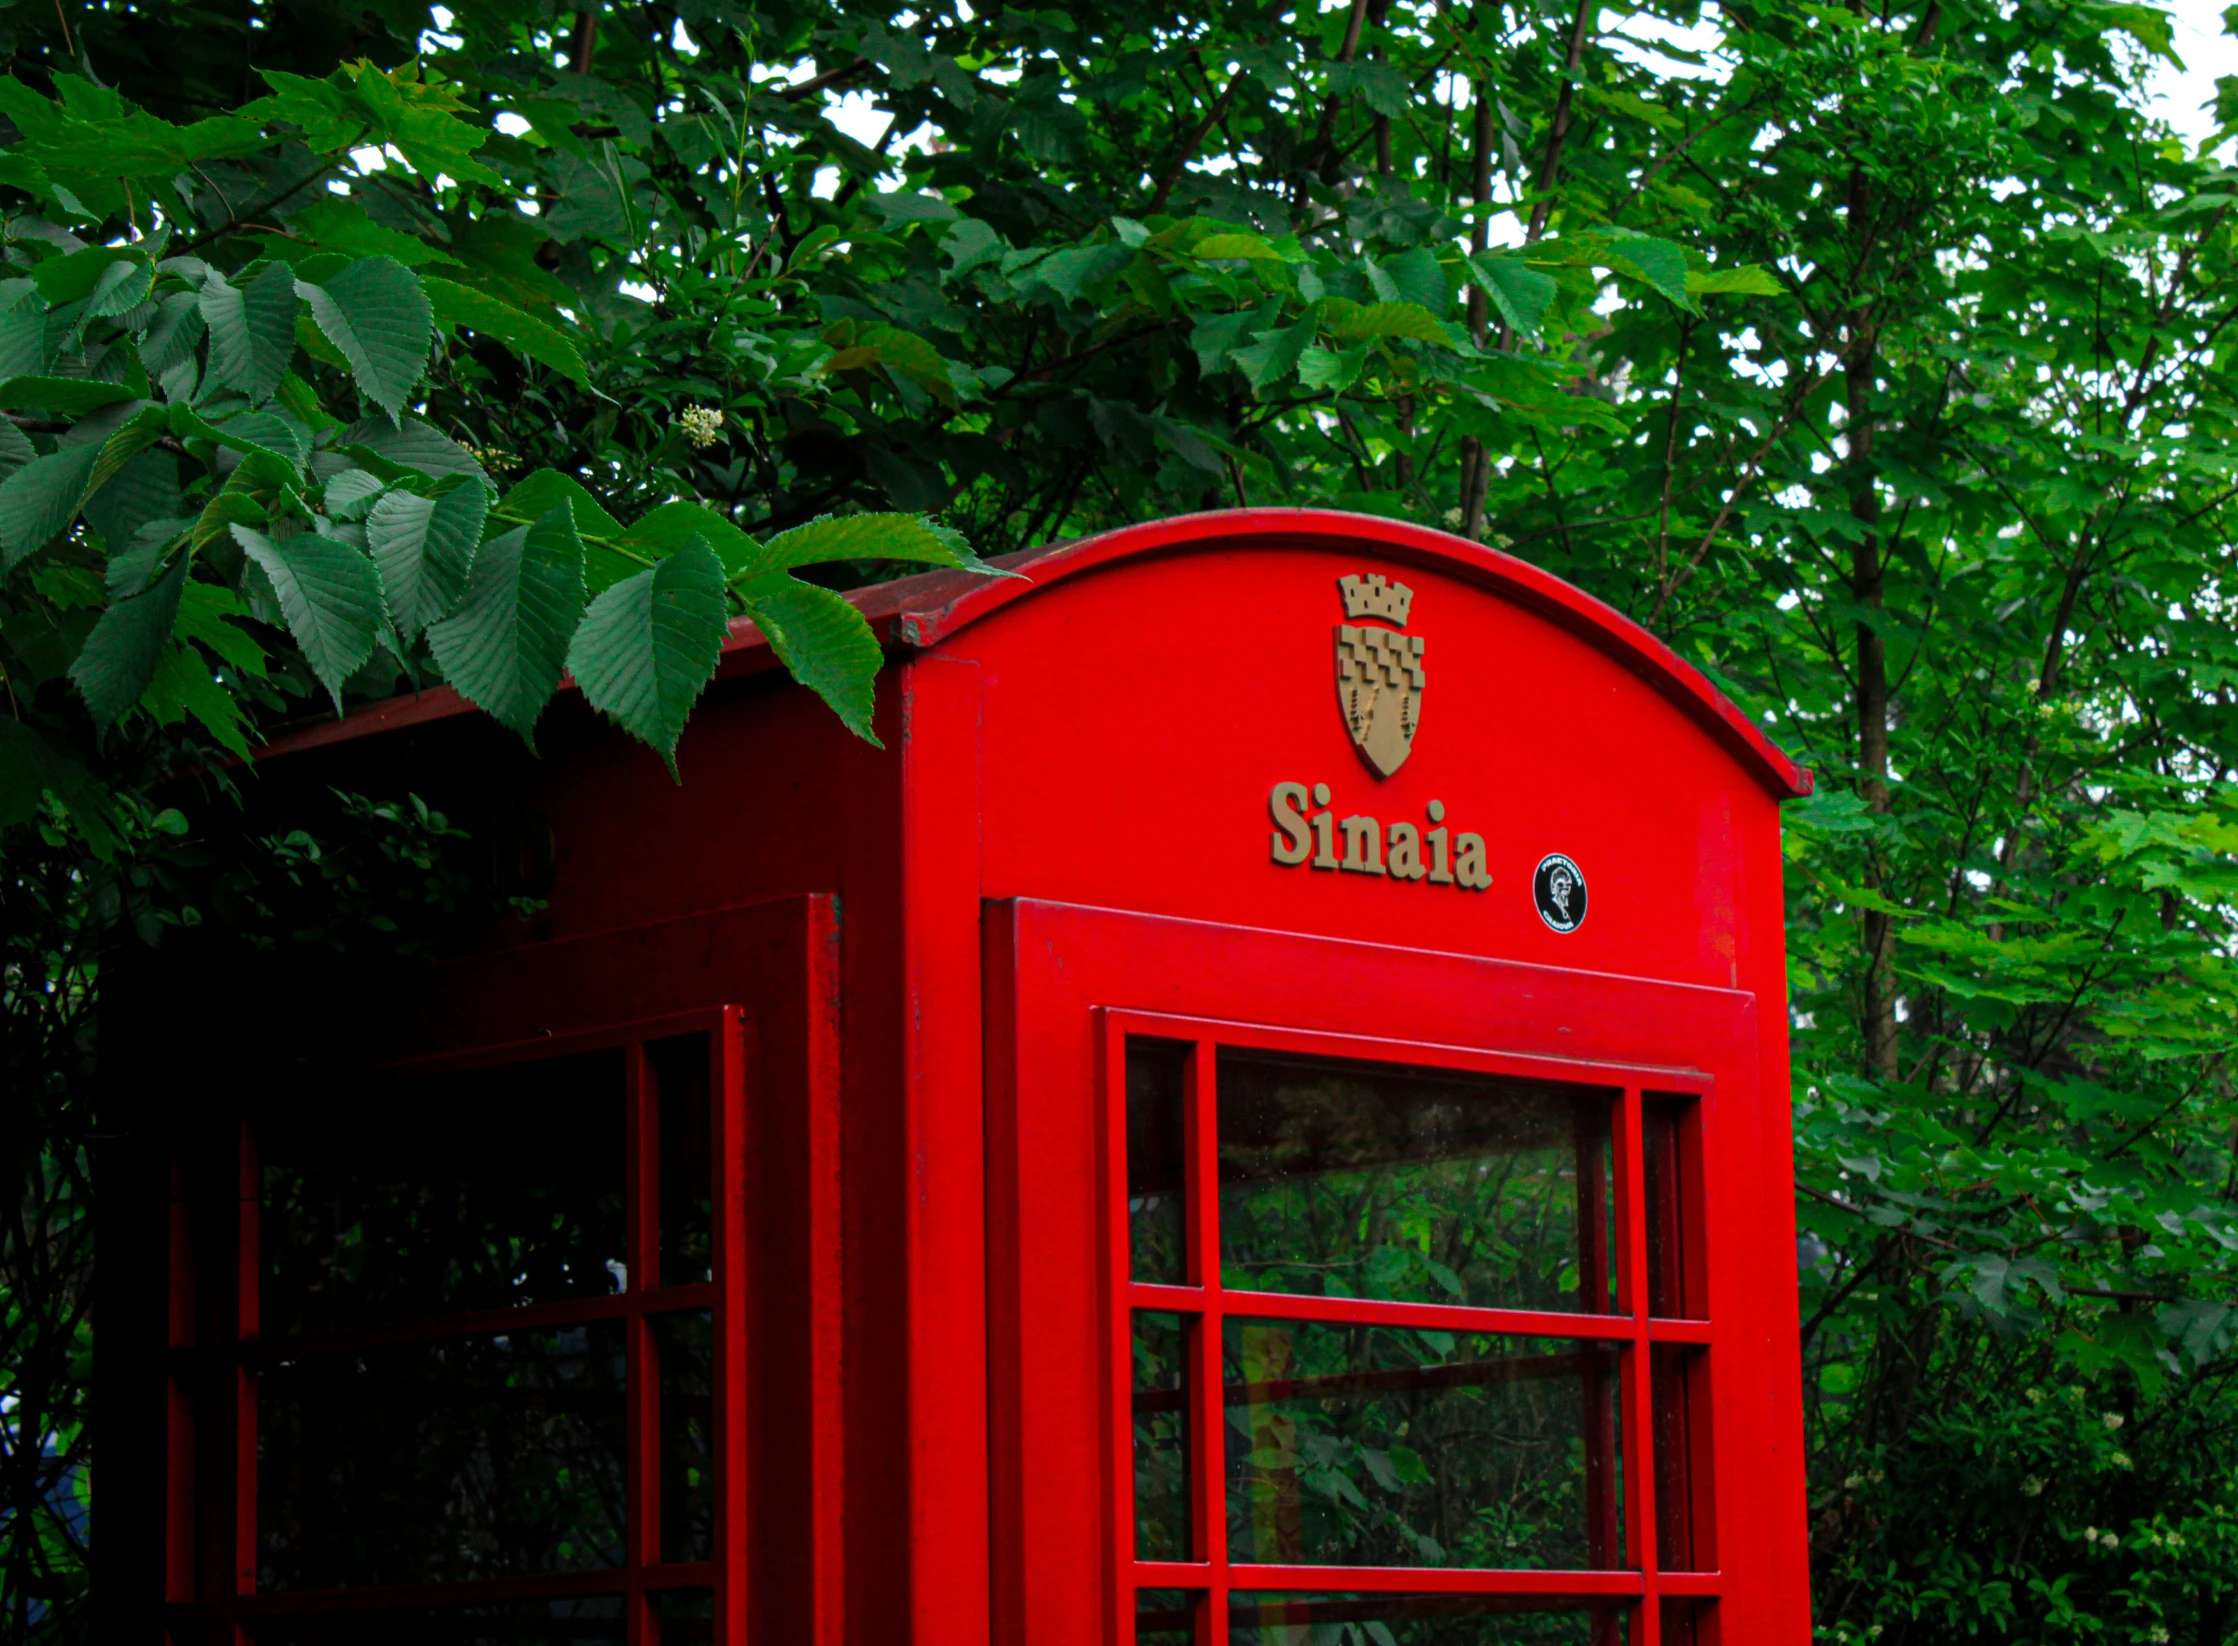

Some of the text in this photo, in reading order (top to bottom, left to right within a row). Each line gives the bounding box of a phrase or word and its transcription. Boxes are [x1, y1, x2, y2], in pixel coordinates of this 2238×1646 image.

[1269, 781, 1493, 891] Sinaia
[1541, 857, 1582, 887] PRAETORIA
[1543, 910, 1574, 930] CRAIOVA
